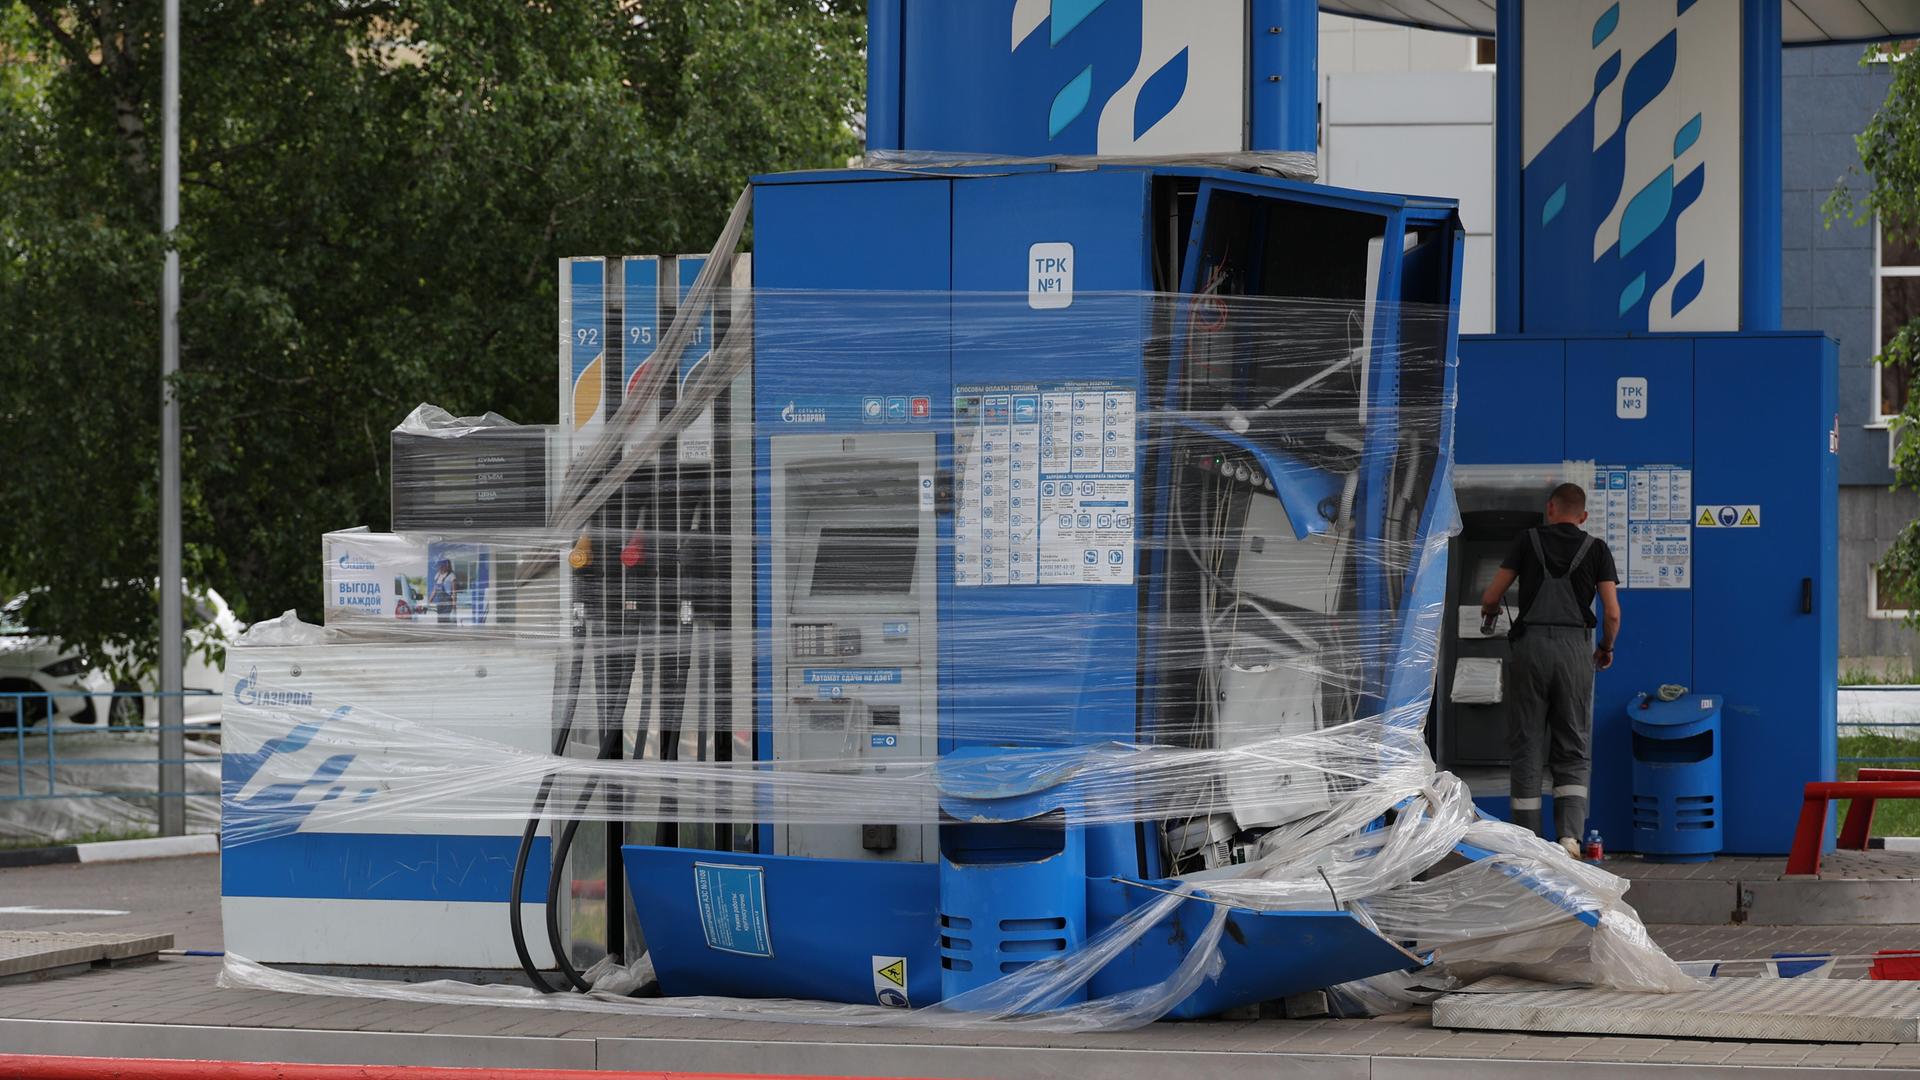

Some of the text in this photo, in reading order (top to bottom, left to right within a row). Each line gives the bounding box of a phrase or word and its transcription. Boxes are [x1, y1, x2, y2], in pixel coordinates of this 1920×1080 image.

[1035, 257, 1067, 273] ТРК
[1038, 278, 1062, 293] №1
[577, 328, 598, 345] 92
[630, 326, 651, 344] 95
[1621, 386, 1642, 397] ТРК
[1622, 399, 1641, 409] №3
[794, 413, 825, 423] ГАЗПРОМ
[339, 582, 381, 595] ВЫГОДА
[339, 595, 381, 607] В КАЖДОЙ
[811, 672, 840, 682] Автомат
[841, 673, 863, 682] сдачи
[256, 690, 313, 706] ГАЗПРОМ
[701, 890, 710, 902] АЗС
[739, 893, 749, 932] круглосуточно
[734, 914, 742, 931] Режим
